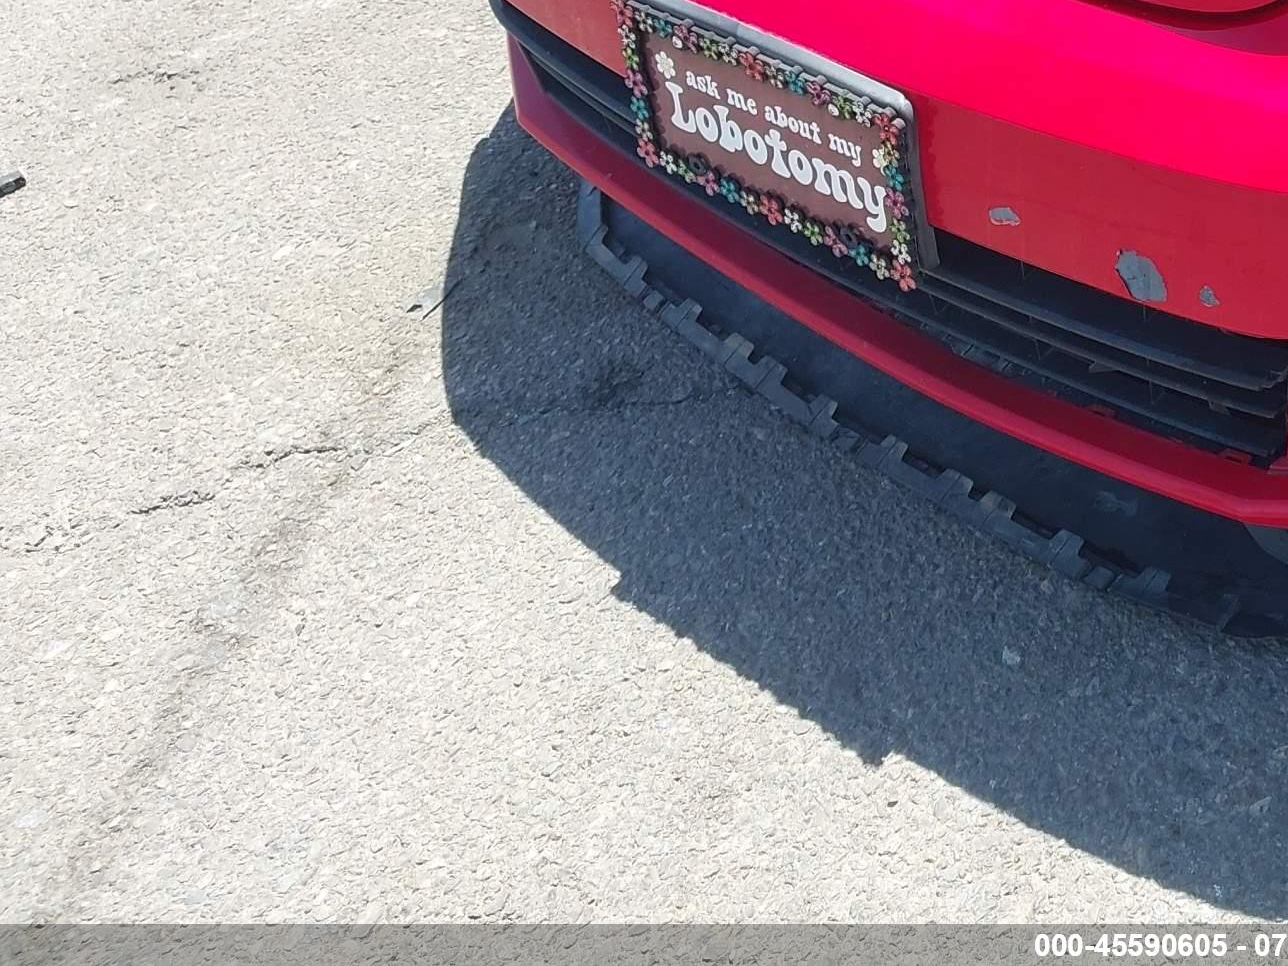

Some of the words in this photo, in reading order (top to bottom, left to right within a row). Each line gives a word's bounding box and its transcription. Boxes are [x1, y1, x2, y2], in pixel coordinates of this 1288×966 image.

[665, 82, 887, 233] Lobotomy
[685, 71, 720, 98] ask
[726, 88, 758, 115] me
[764, 106, 822, 144] about
[828, 133, 862, 167] my
